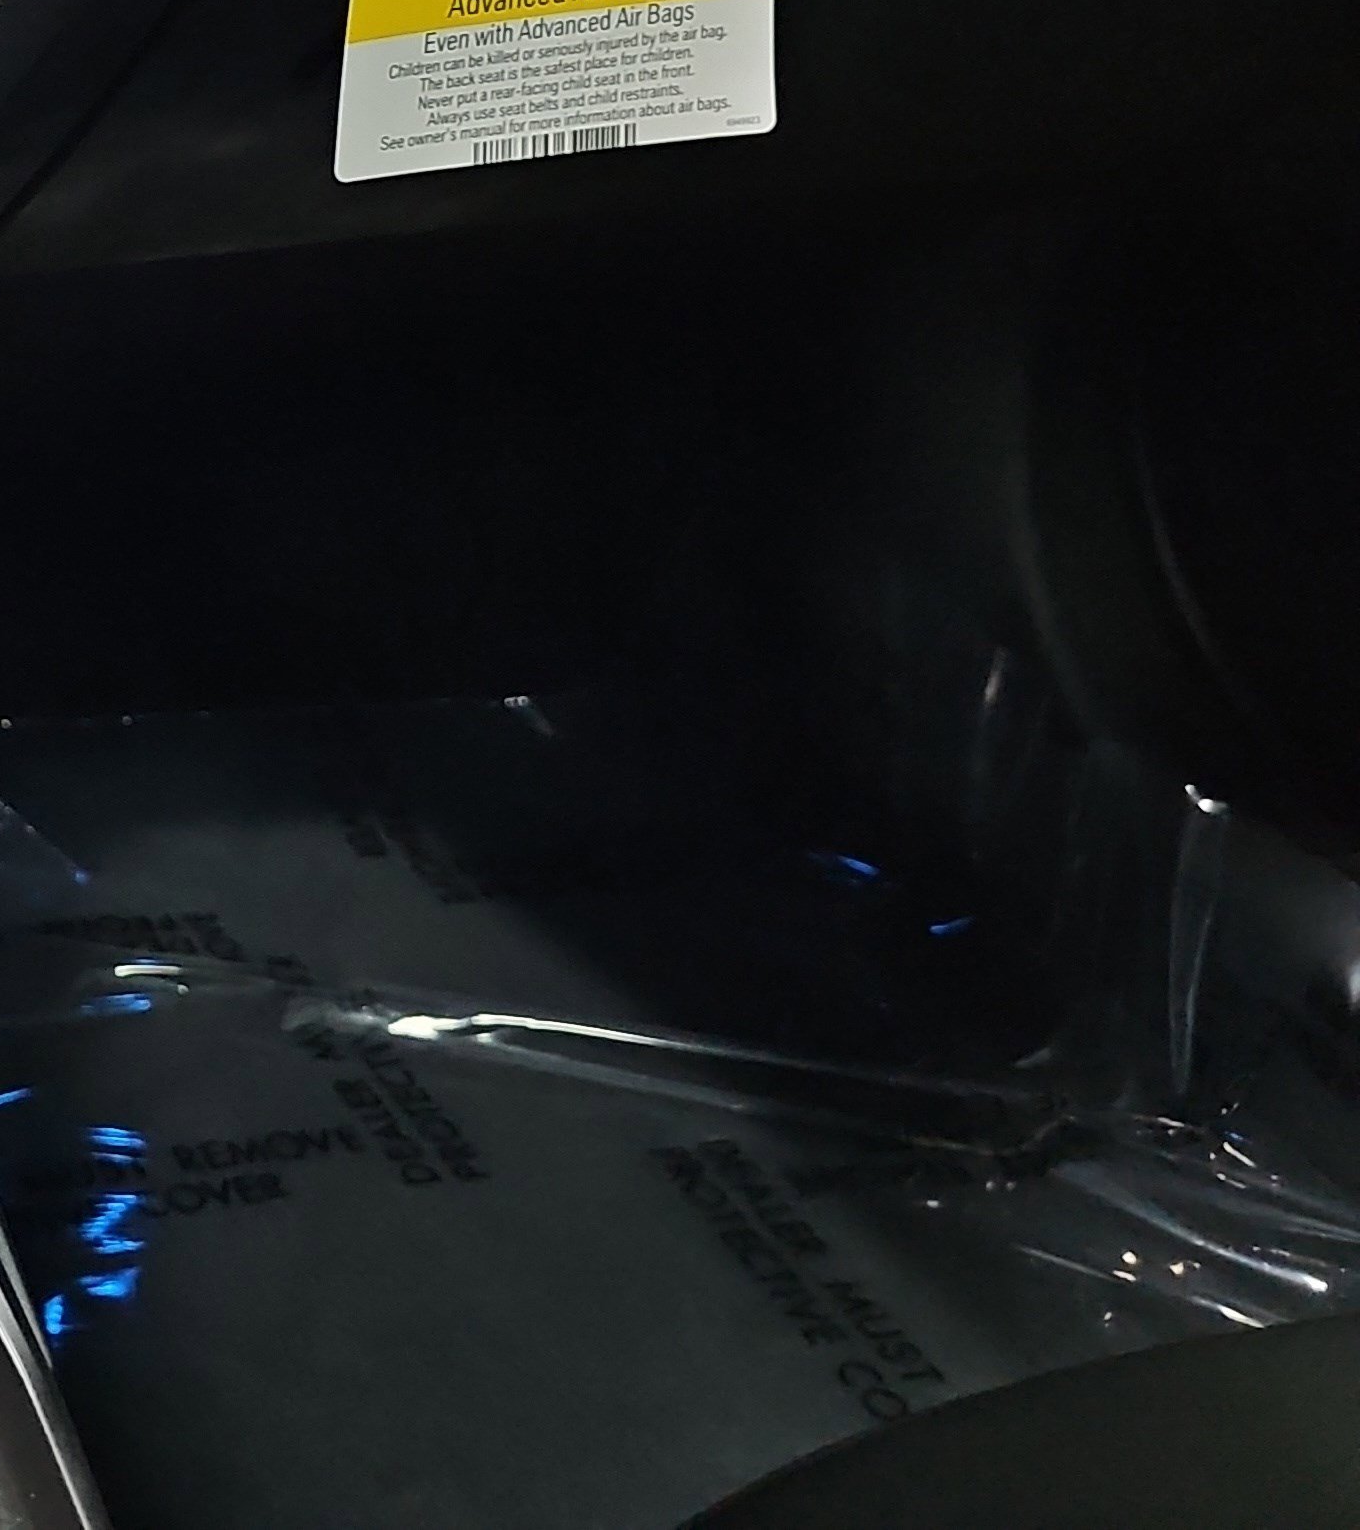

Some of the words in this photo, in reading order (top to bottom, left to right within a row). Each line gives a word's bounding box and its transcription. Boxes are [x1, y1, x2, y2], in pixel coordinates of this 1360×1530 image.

[388, 61, 440, 79] Children
[443, 59, 465, 72] can
[468, 54, 483, 68] be
[487, 48, 519, 64] killed
[522, 49, 535, 61] or
[538, 39, 593, 58] seriously
[596, 33, 637, 53] injured
[641, 33, 656, 48] by
[659, 30, 679, 44] the
[682, 28, 698, 42] air
[701, 25, 727, 41] bag.
[424, 32, 469, 54] Even
[475, 23, 513, 46] with
[517, 9, 611, 41] Advanced
[615, 6, 642, 28] Air
[647, 3, 695, 27] Bags
[417, 95, 453, 110] Never
[457, 91, 478, 107] put
[480, 91, 488, 102] a
[491, 80, 559, 100] rear-facing
[561, 75, 592, 91] child
[594, 72, 621, 87] seat
[623, 70, 635, 83] in
[639, 67, 658, 81] the
[661, 63, 695, 78] front.
[420, 77, 443, 92] The
[446, 73, 475, 89] back
[478, 69, 505, 84] seat
[508, 68, 518, 80] is
[521, 64, 540, 78] the
[543, 58, 580, 76] safest
[584, 55, 617, 72] place
[621, 51, 637, 65] for
[641, 47, 694, 64] children.
[380, 135, 404, 151] See
[407, 127, 456, 147] owner's
[460, 121, 506, 139] manual
[508, 118, 527, 133] for
[530, 116, 561, 130] more
[563, 107, 636, 126] information
[639, 101, 675, 117] about
[679, 99, 694, 113] air
[697, 96, 732, 113] bags.
[426, 111, 470, 127] Always
[474, 107, 496, 120] use
[499, 102, 526, 116] seat
[529, 98, 559, 113] belts
[562, 93, 584, 109] and
[587, 90, 617, 106] child
[621, 84, 684, 101] restraints.
